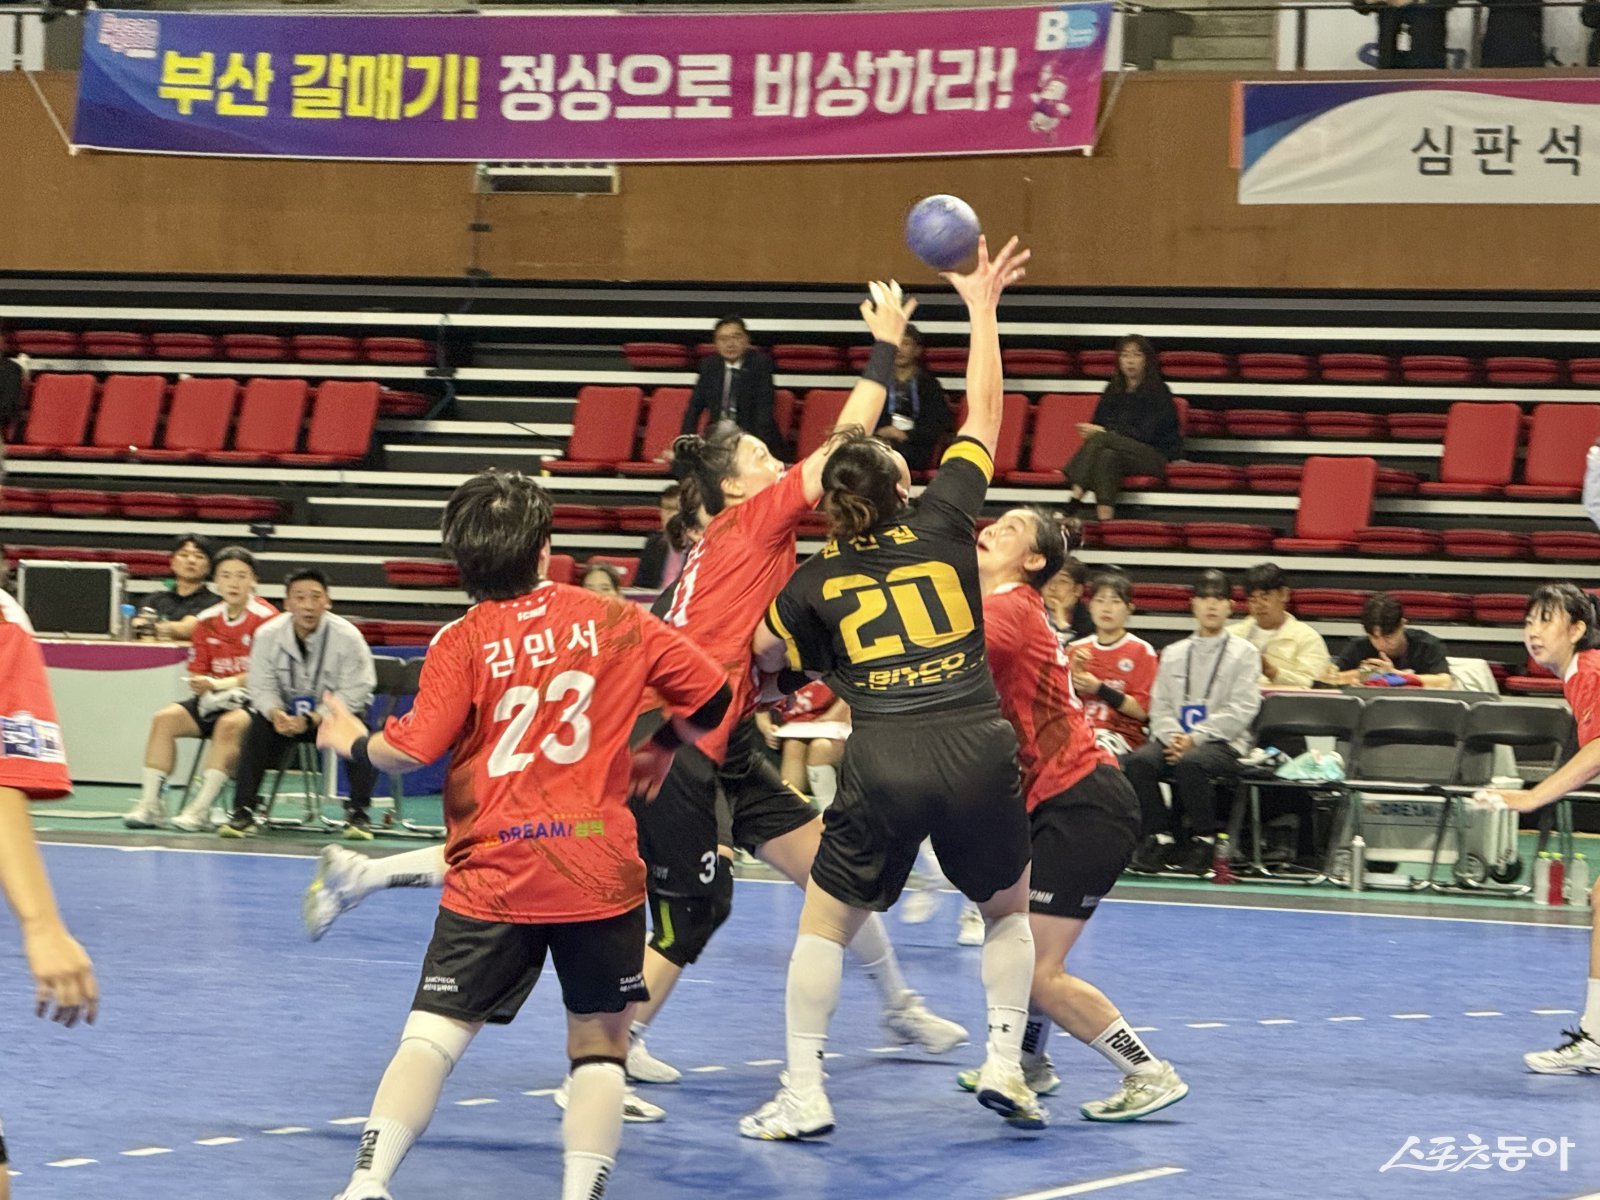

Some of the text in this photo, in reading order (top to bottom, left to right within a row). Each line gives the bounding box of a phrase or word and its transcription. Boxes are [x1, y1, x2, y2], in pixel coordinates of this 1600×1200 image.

[158, 46, 1017, 122] 부산 갈매기! 정상으로 비상하라!
[822, 560, 975, 664] 20
[483, 619, 600, 680] 김민서
[487, 670, 596, 778] 23
[699, 850, 716, 885] 3
[1105, 1028, 1151, 1066] FCMM
